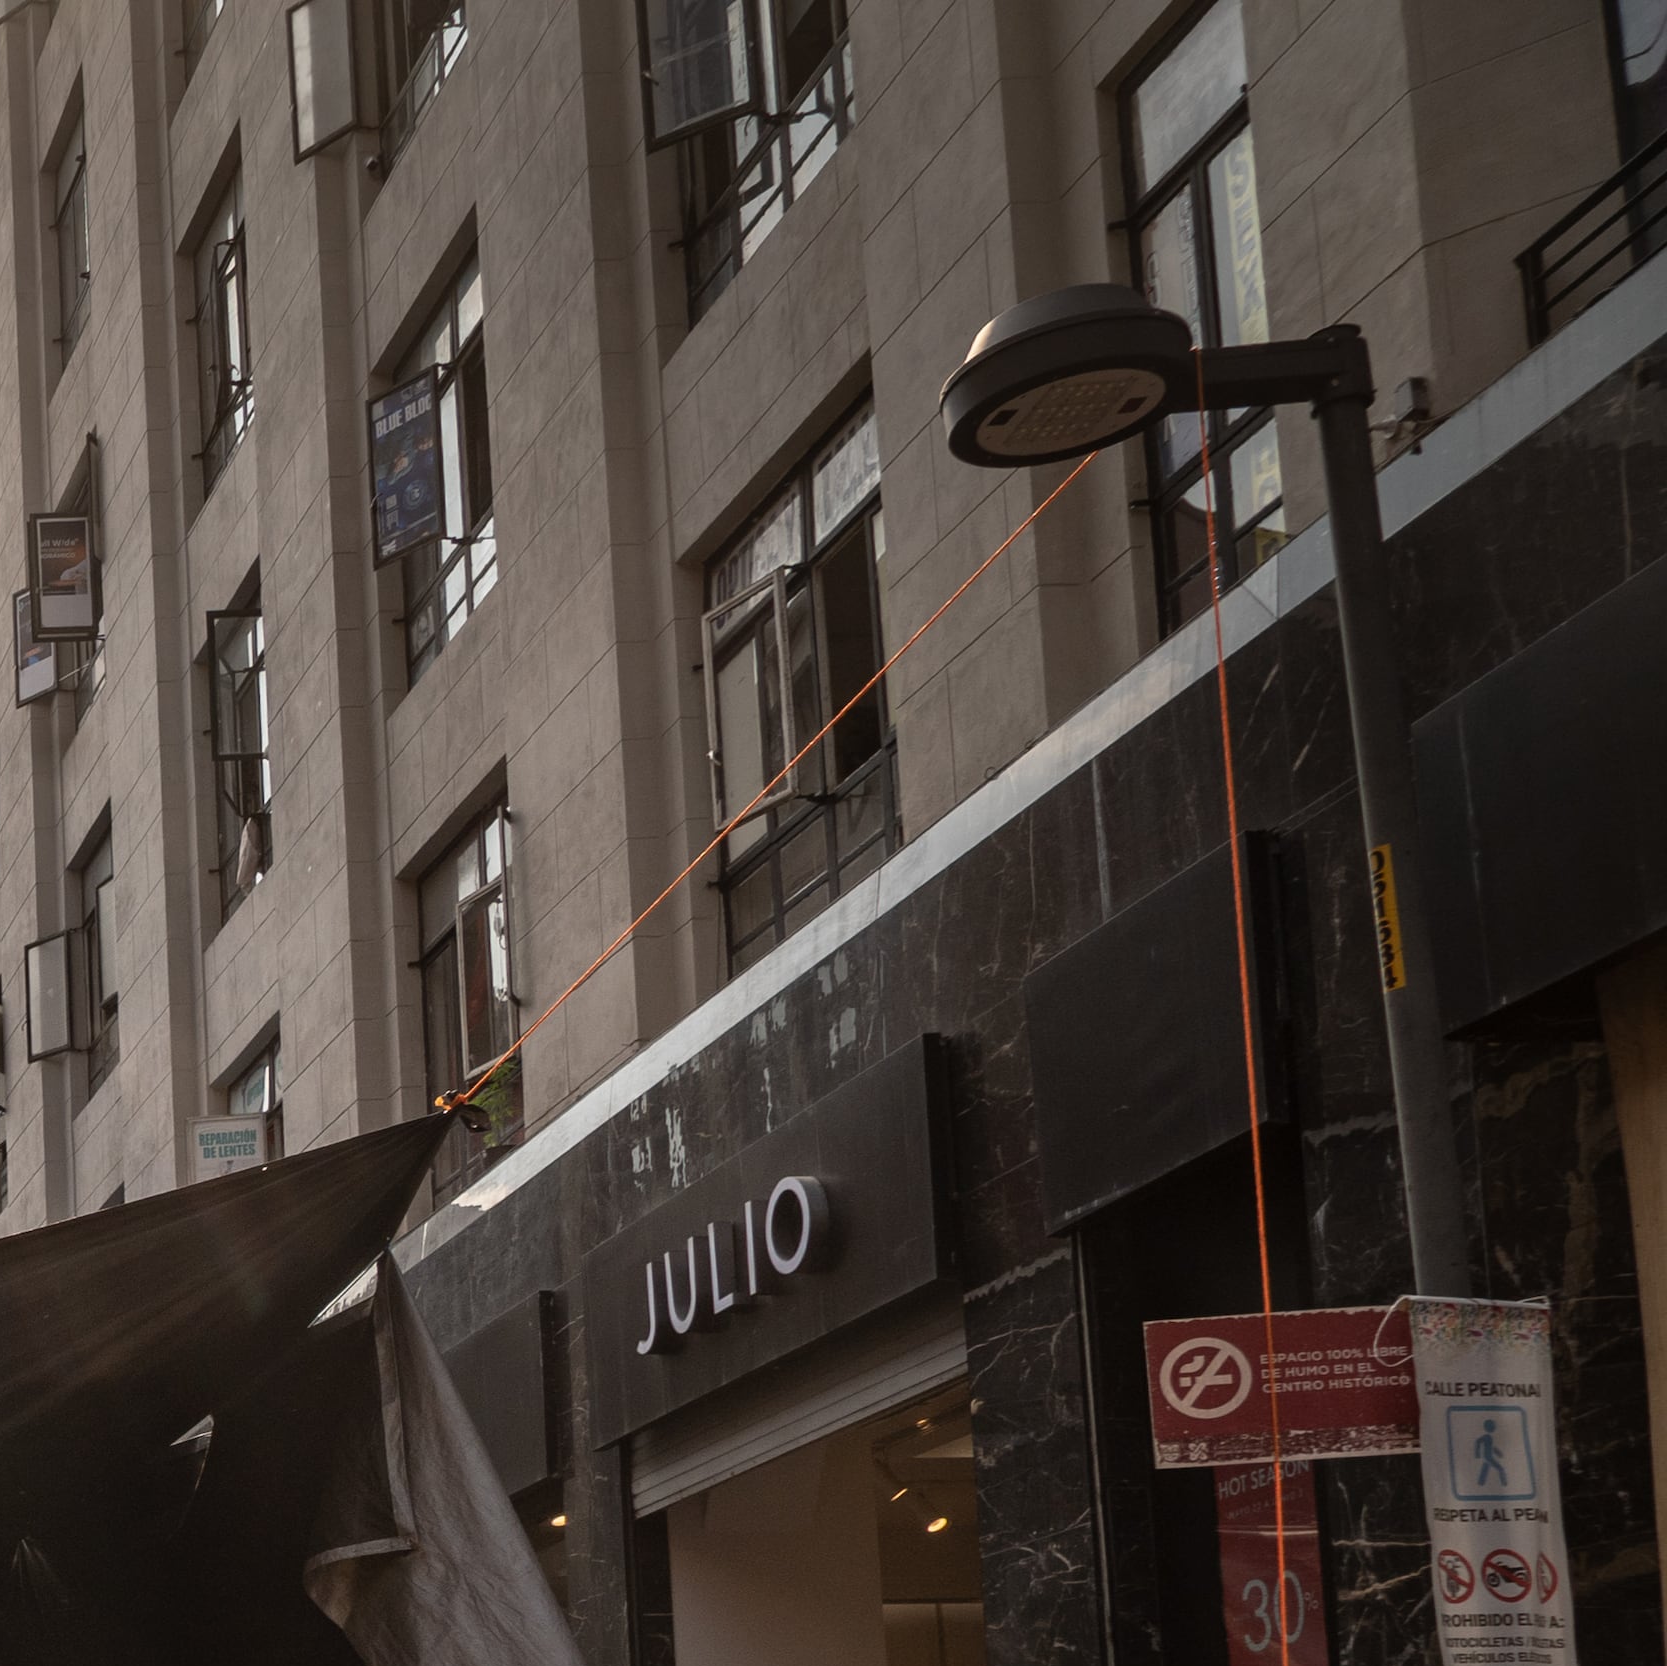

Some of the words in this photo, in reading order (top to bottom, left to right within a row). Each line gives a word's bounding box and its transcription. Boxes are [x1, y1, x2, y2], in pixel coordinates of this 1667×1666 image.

[198, 1129, 257, 1146] REPARACIÓN
[203, 1146, 217, 1158] DE
[218, 1144, 256, 1158] LENTES
[636, 1176, 817, 1354] JULIO
[1326, 1347, 1364, 1361] 100%
[1260, 1367, 1282, 1380] DE
[1285, 1365, 1330, 1378] HUMO
[1333, 1363, 1354, 1375] EN
[1357, 1361, 1377, 1373] EL
[1262, 1380, 1324, 1394] CENTRO
[1328, 1371, 1411, 1390] HISTÓRICO
[1217, 1474, 1248, 1502] HOT
[1491, 1509, 1511, 1521] AL
